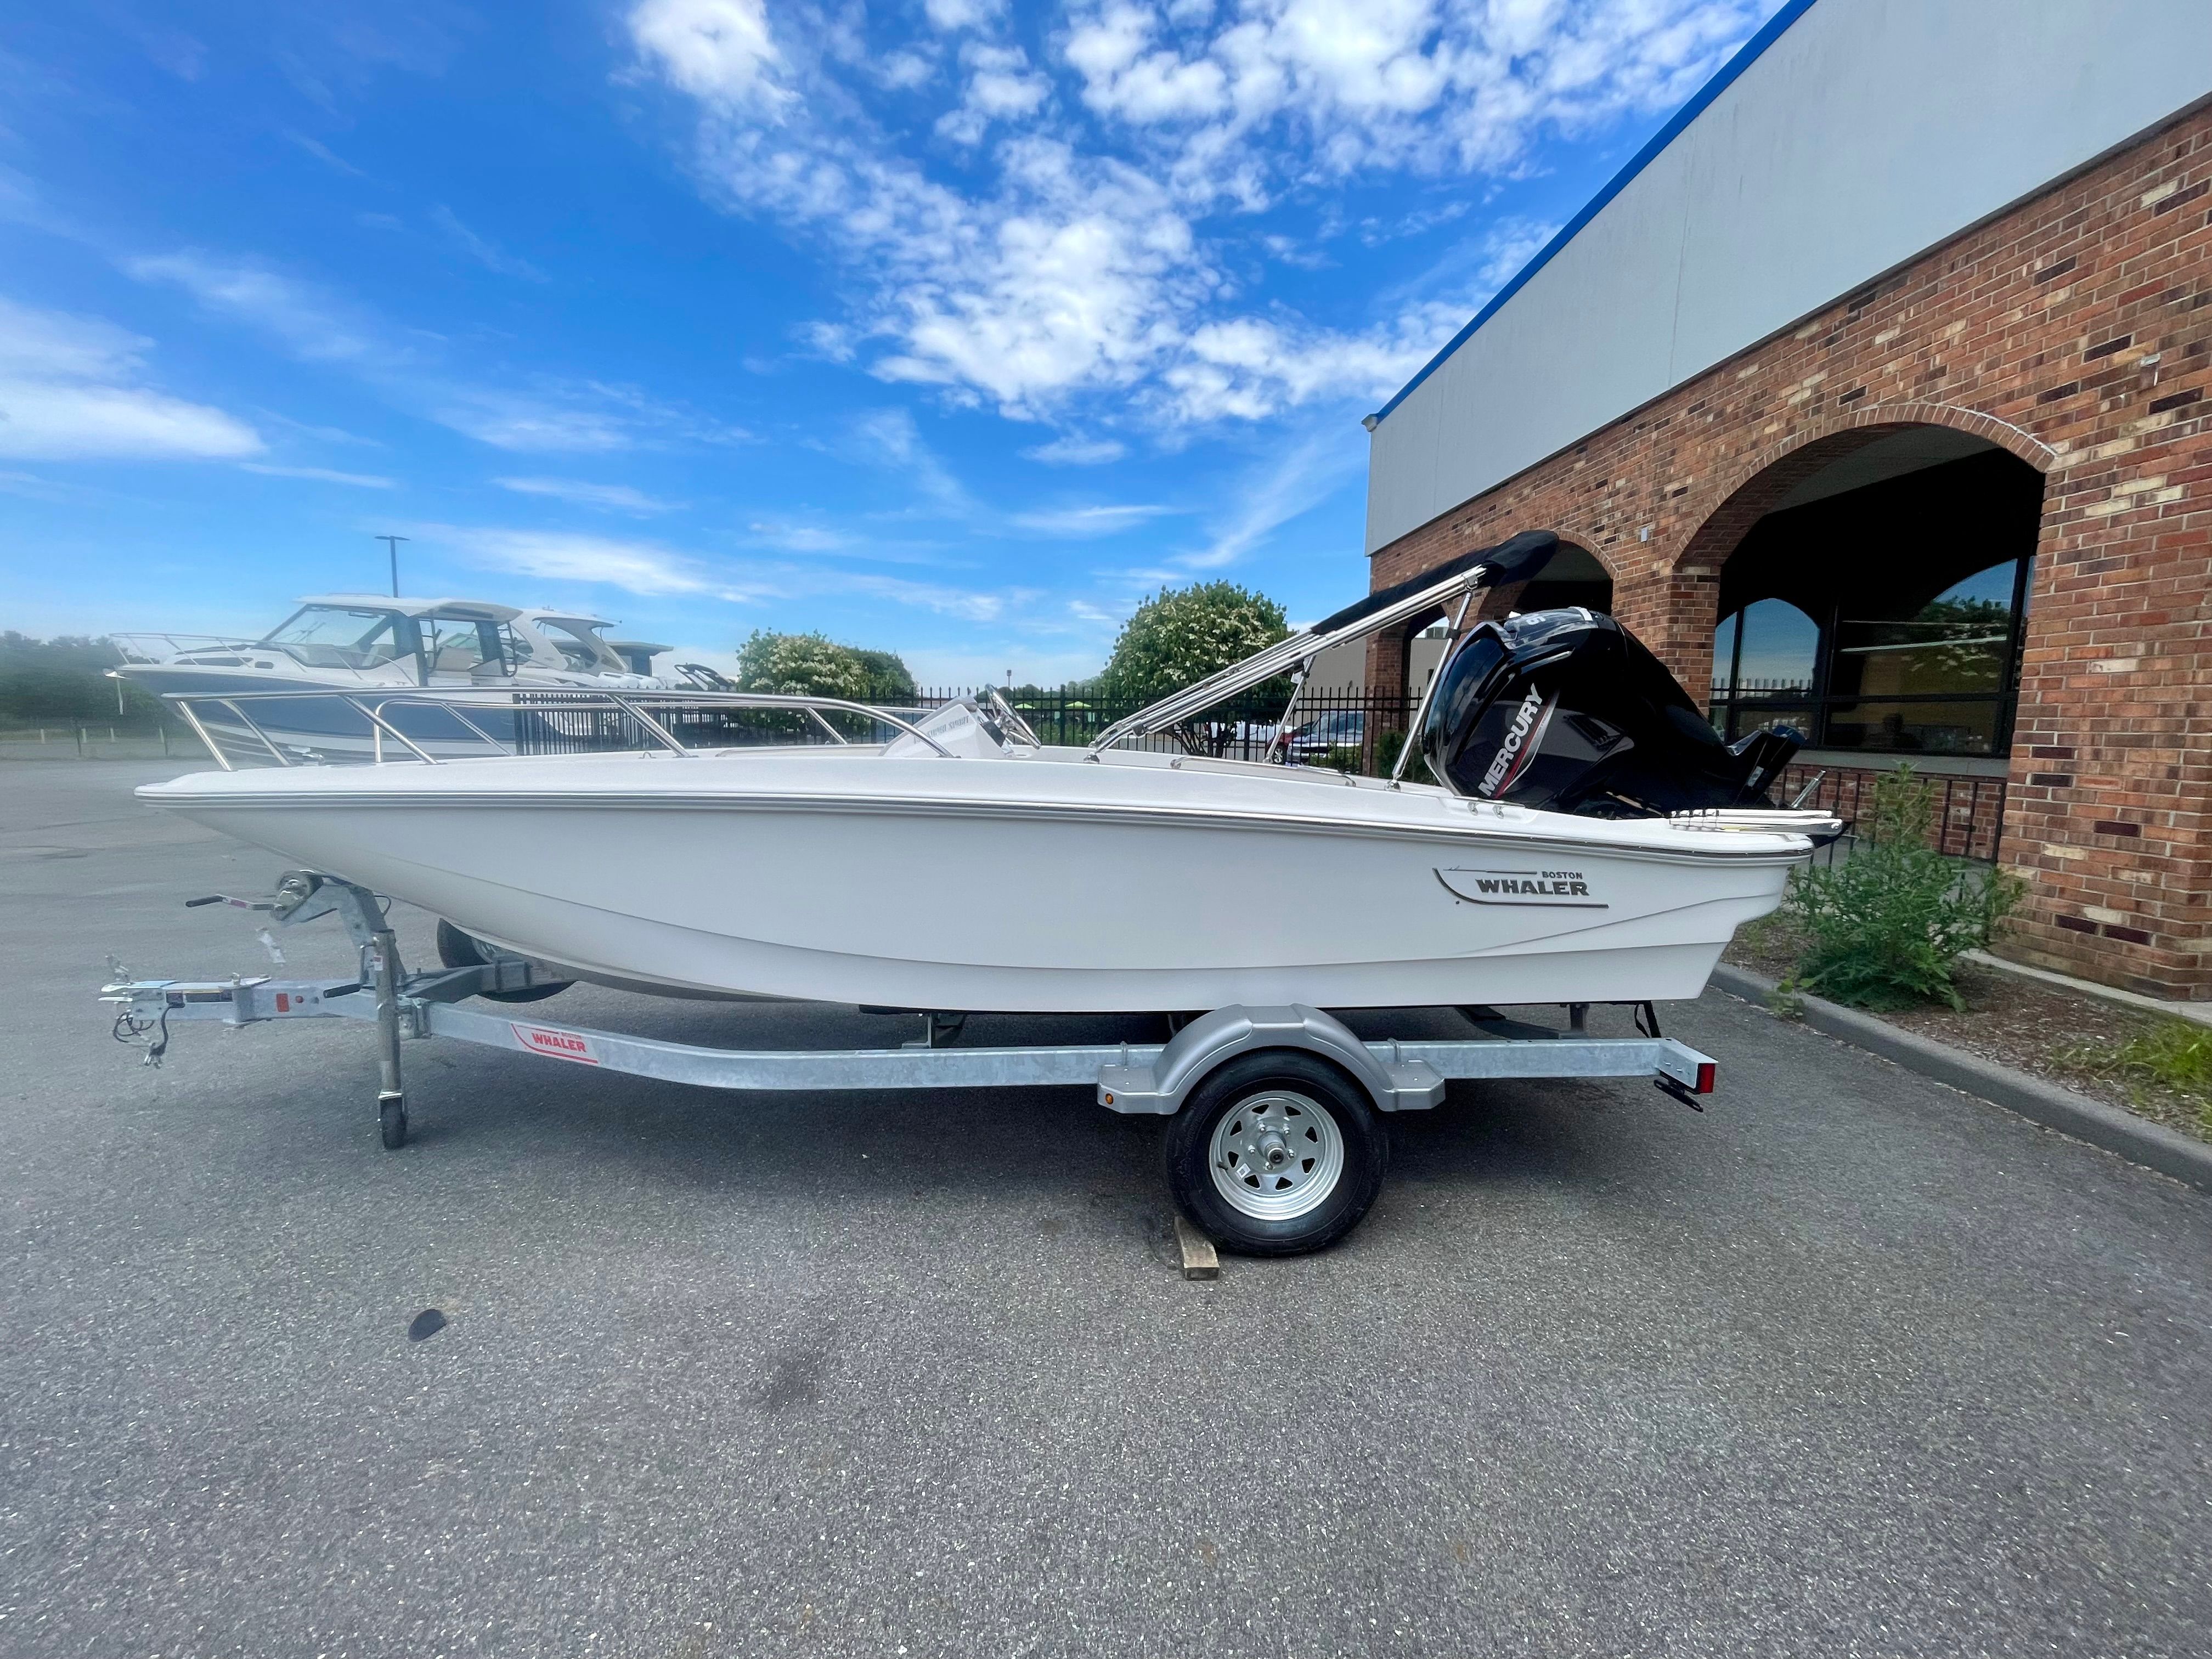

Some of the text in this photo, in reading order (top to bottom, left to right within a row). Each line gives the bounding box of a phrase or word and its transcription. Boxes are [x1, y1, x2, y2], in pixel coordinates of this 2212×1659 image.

[1478, 682, 1543, 797] MERCURY
[1542, 871, 1583, 879] BOSTON
[1475, 879, 1590, 896] WHALER
[532, 1032, 586, 1052] WHALER
